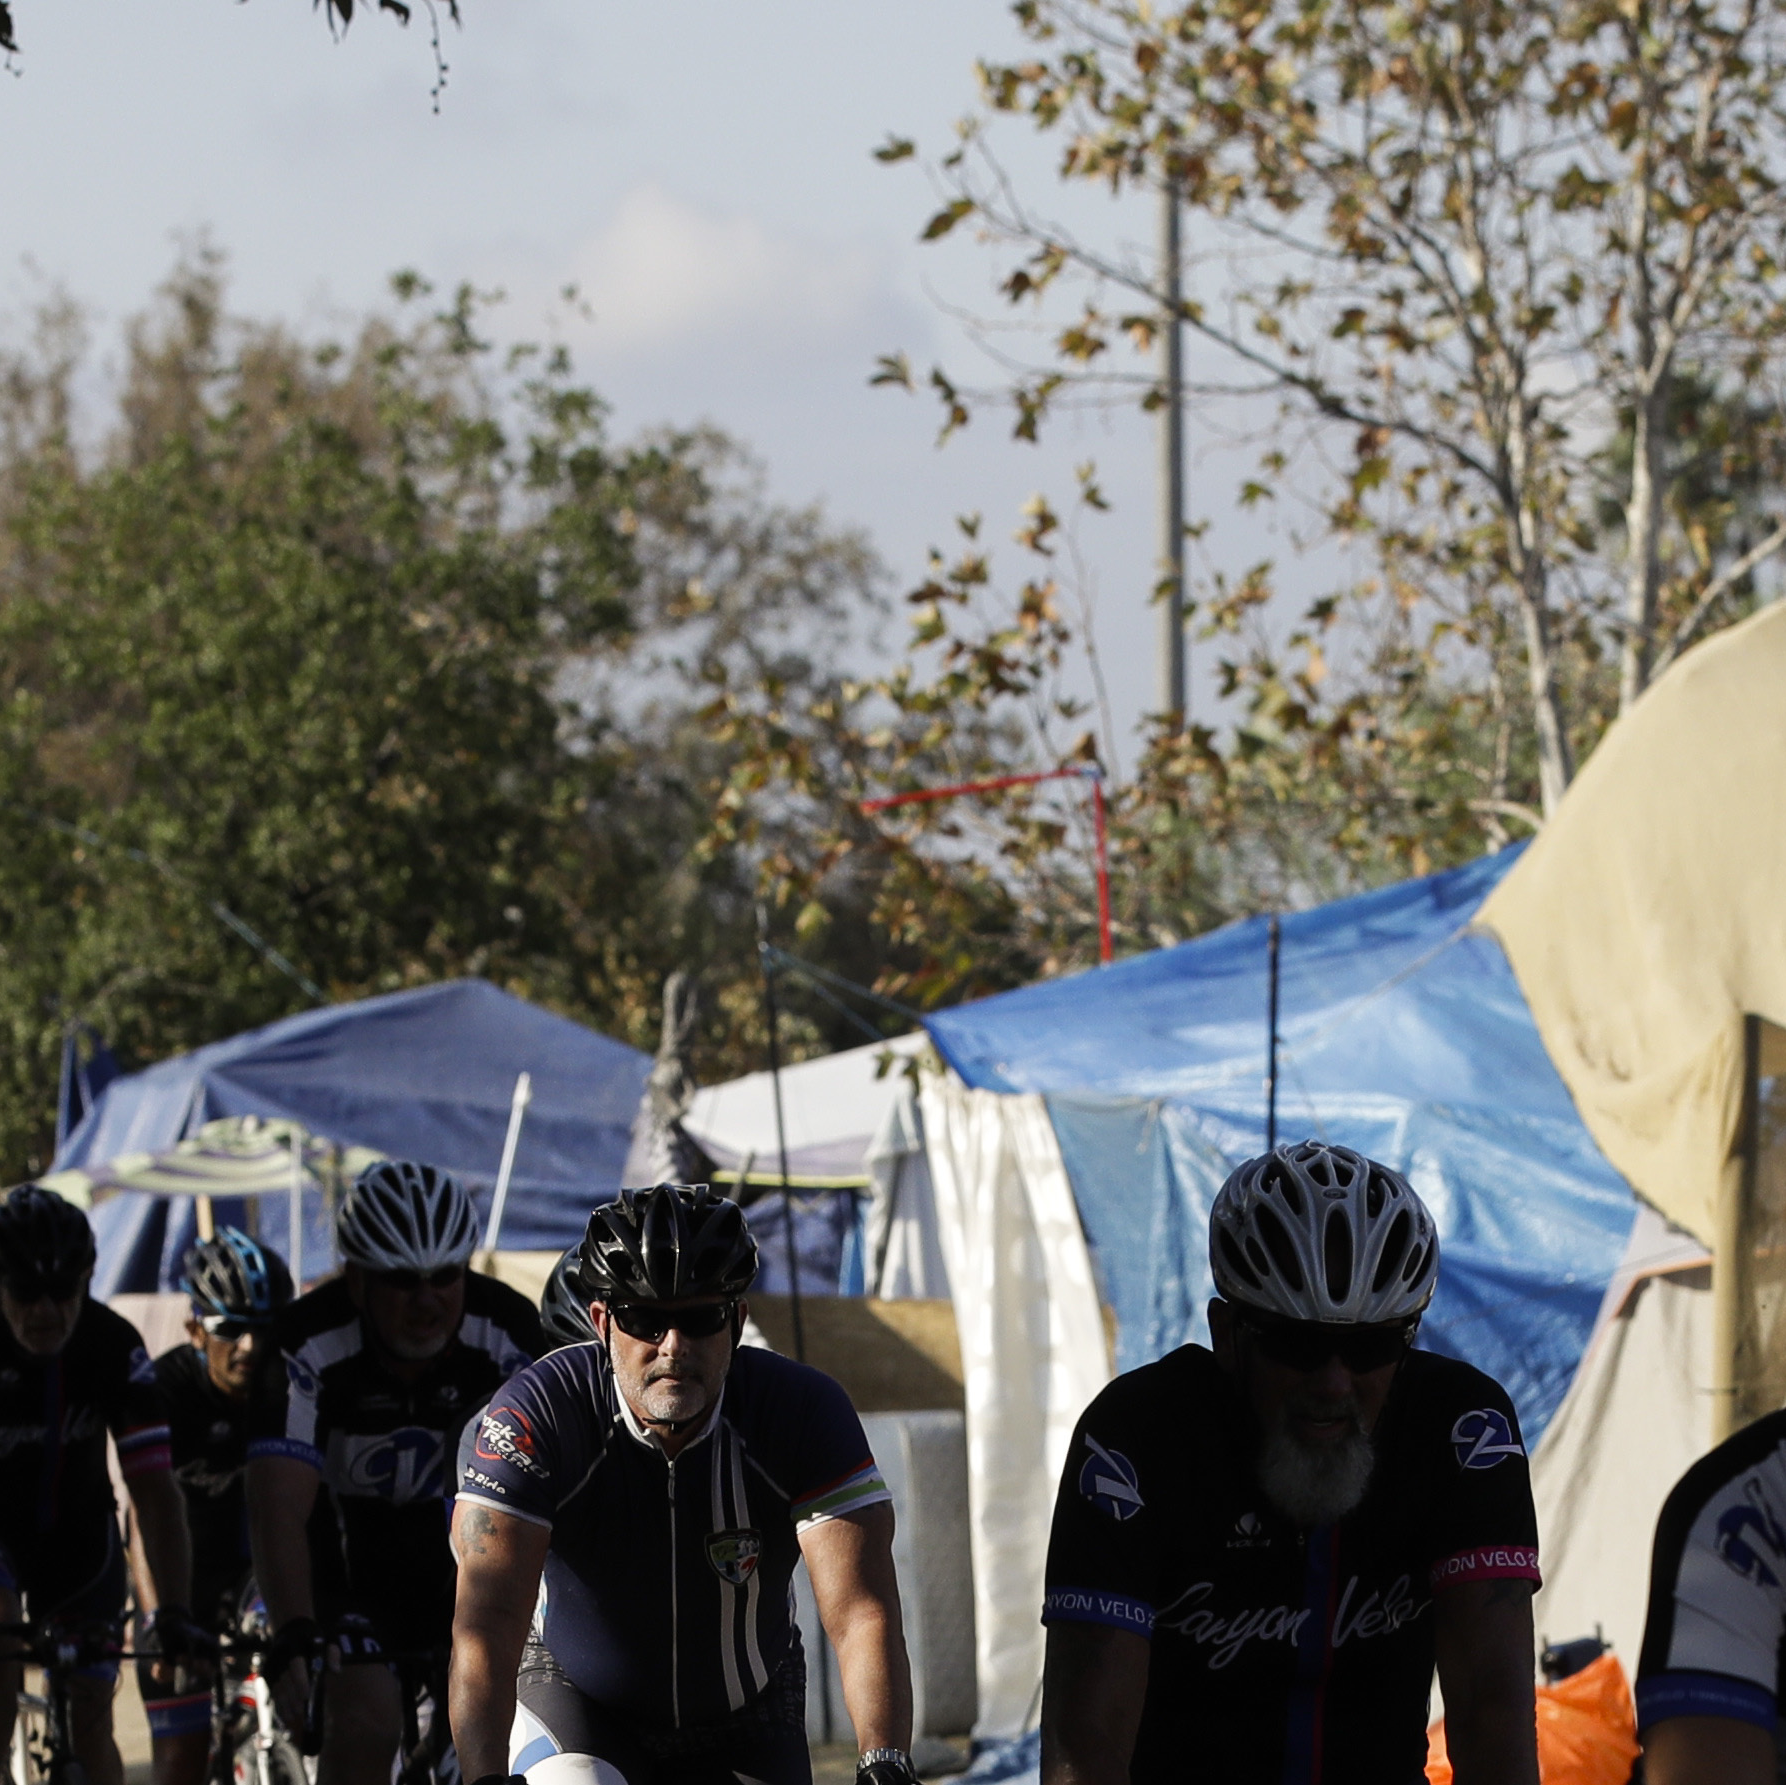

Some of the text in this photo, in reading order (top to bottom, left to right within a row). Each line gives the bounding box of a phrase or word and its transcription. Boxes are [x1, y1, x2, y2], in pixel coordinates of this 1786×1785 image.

[1430, 1553, 1476, 1581] YON
[1480, 1550, 1527, 1567] VELO
[1098, 1597, 1146, 1624] VELO
